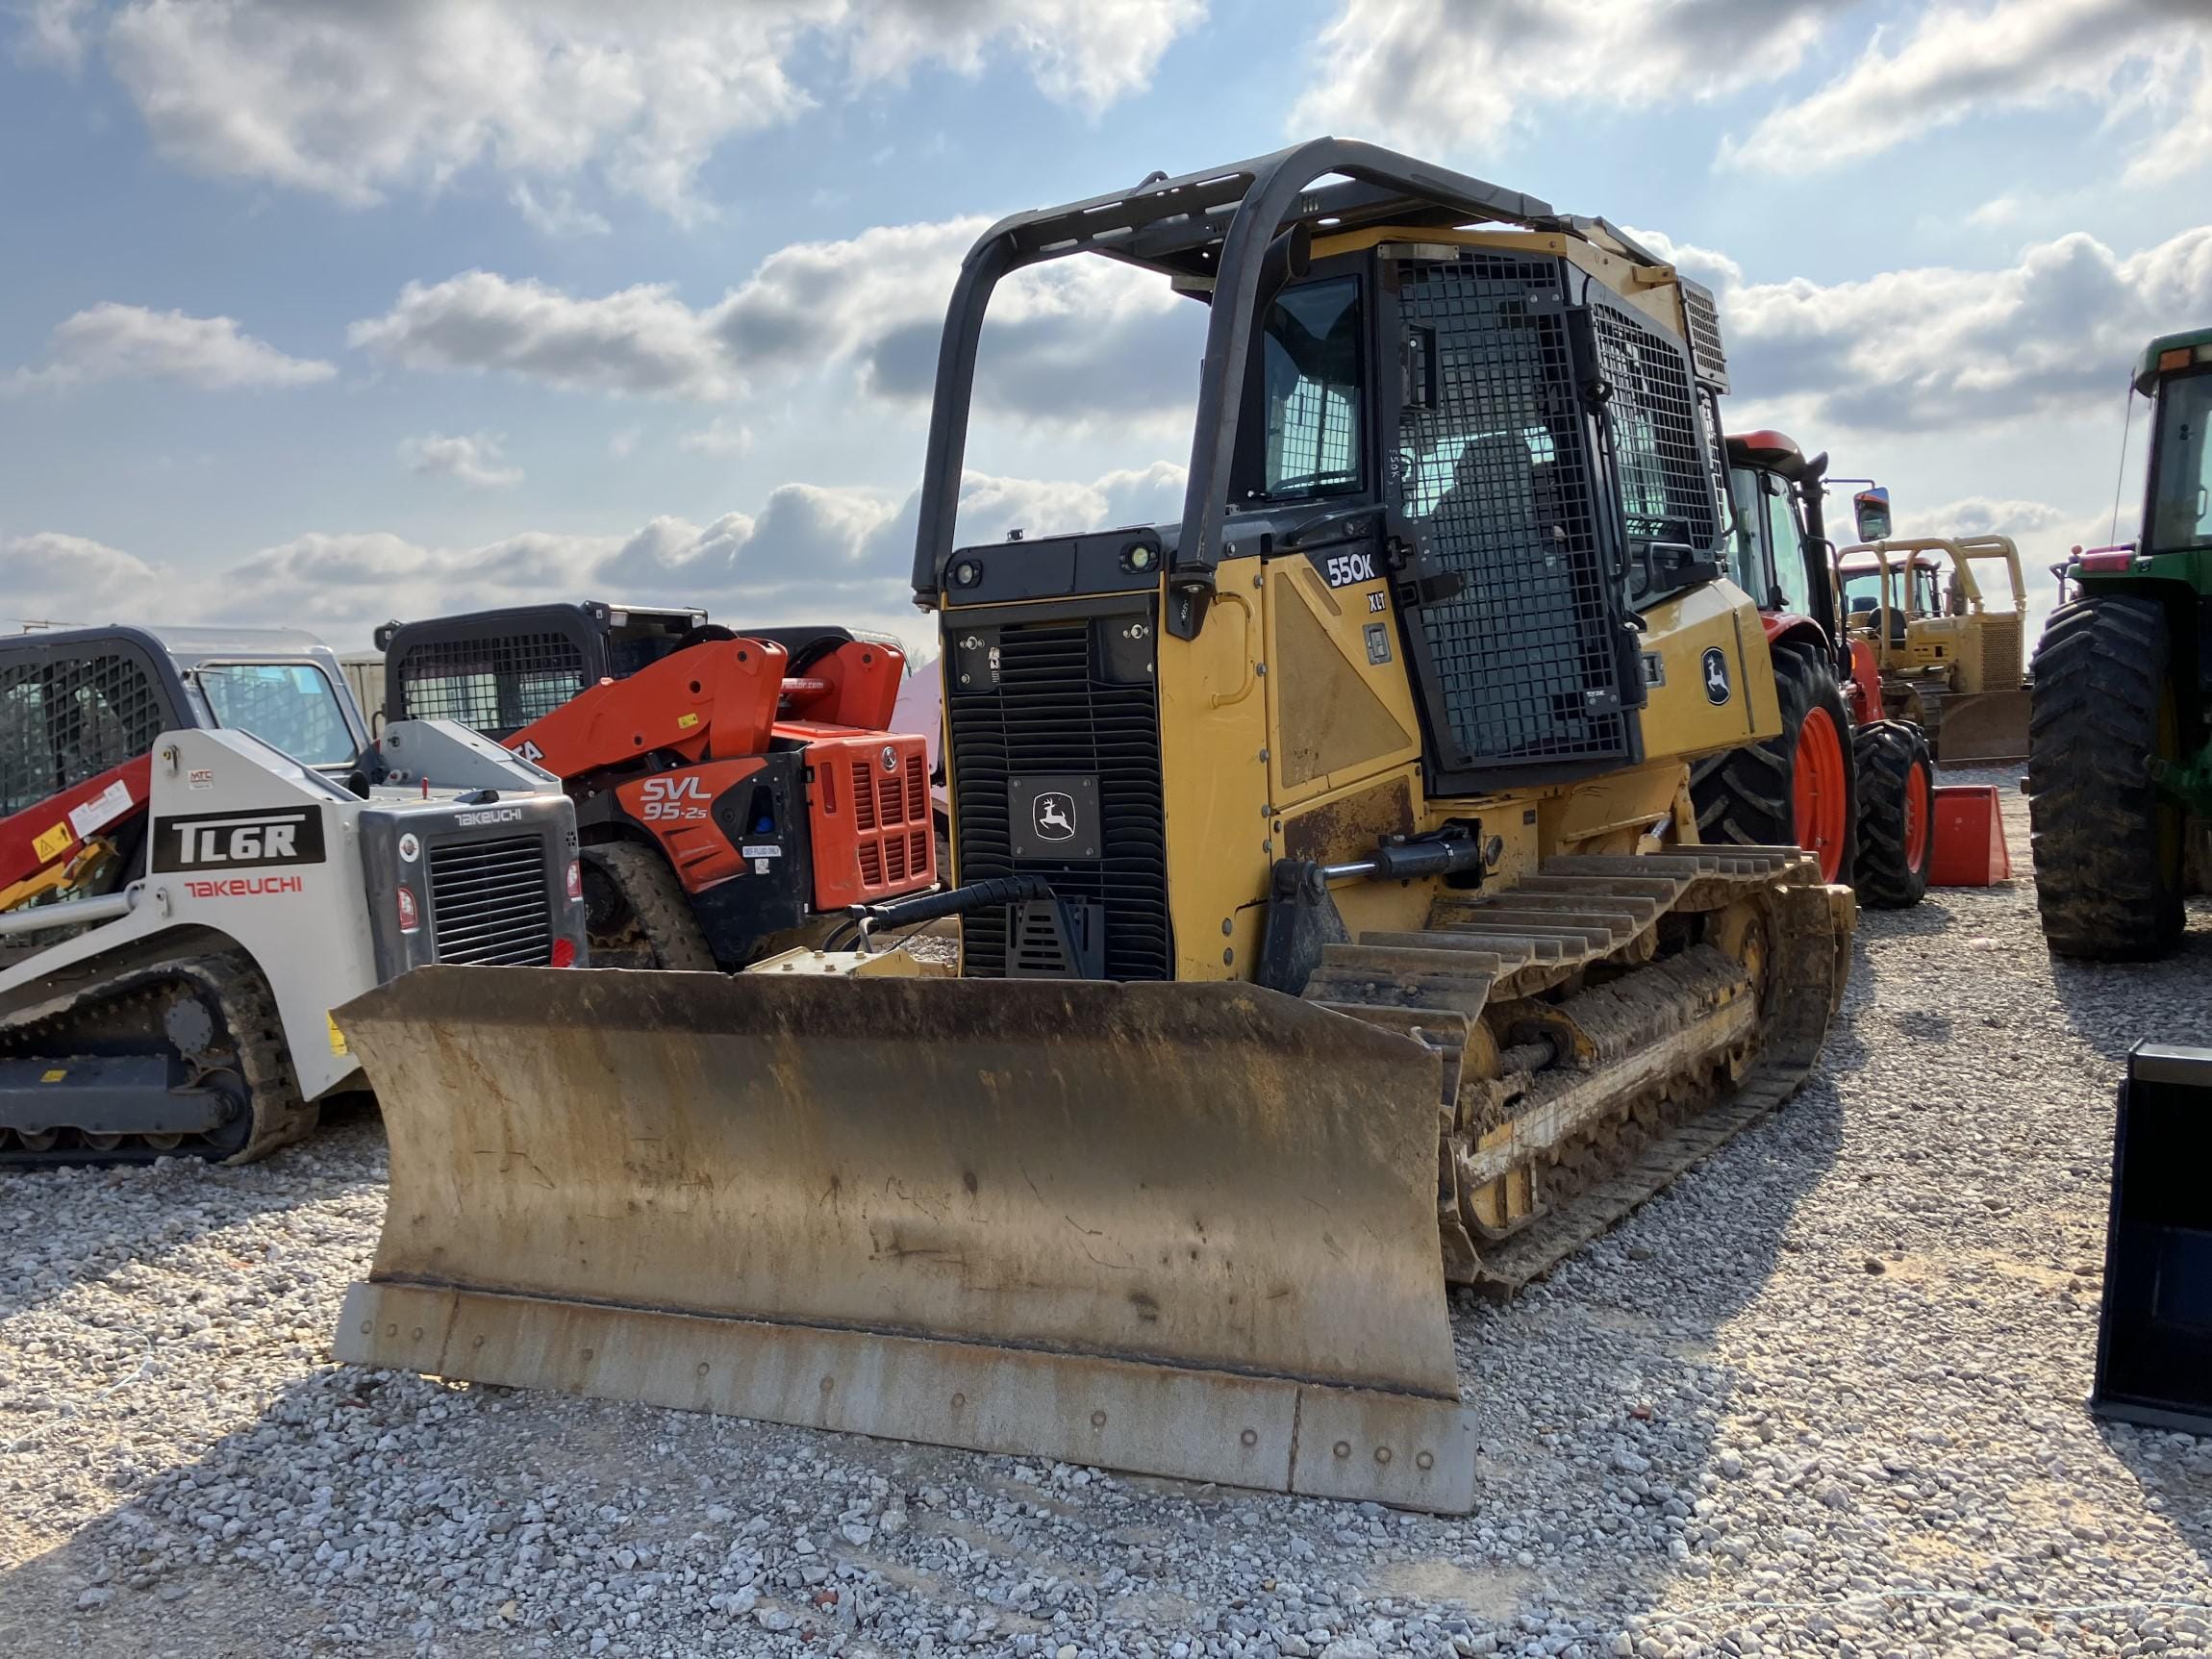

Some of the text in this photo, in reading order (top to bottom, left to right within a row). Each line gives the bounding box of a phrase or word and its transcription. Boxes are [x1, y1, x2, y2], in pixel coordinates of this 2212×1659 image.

[1327, 553, 1375, 587] 550K
[1368, 591, 1386, 613] XLT
[641, 776, 712, 801] SVL
[171, 814, 306, 864] TL6R
